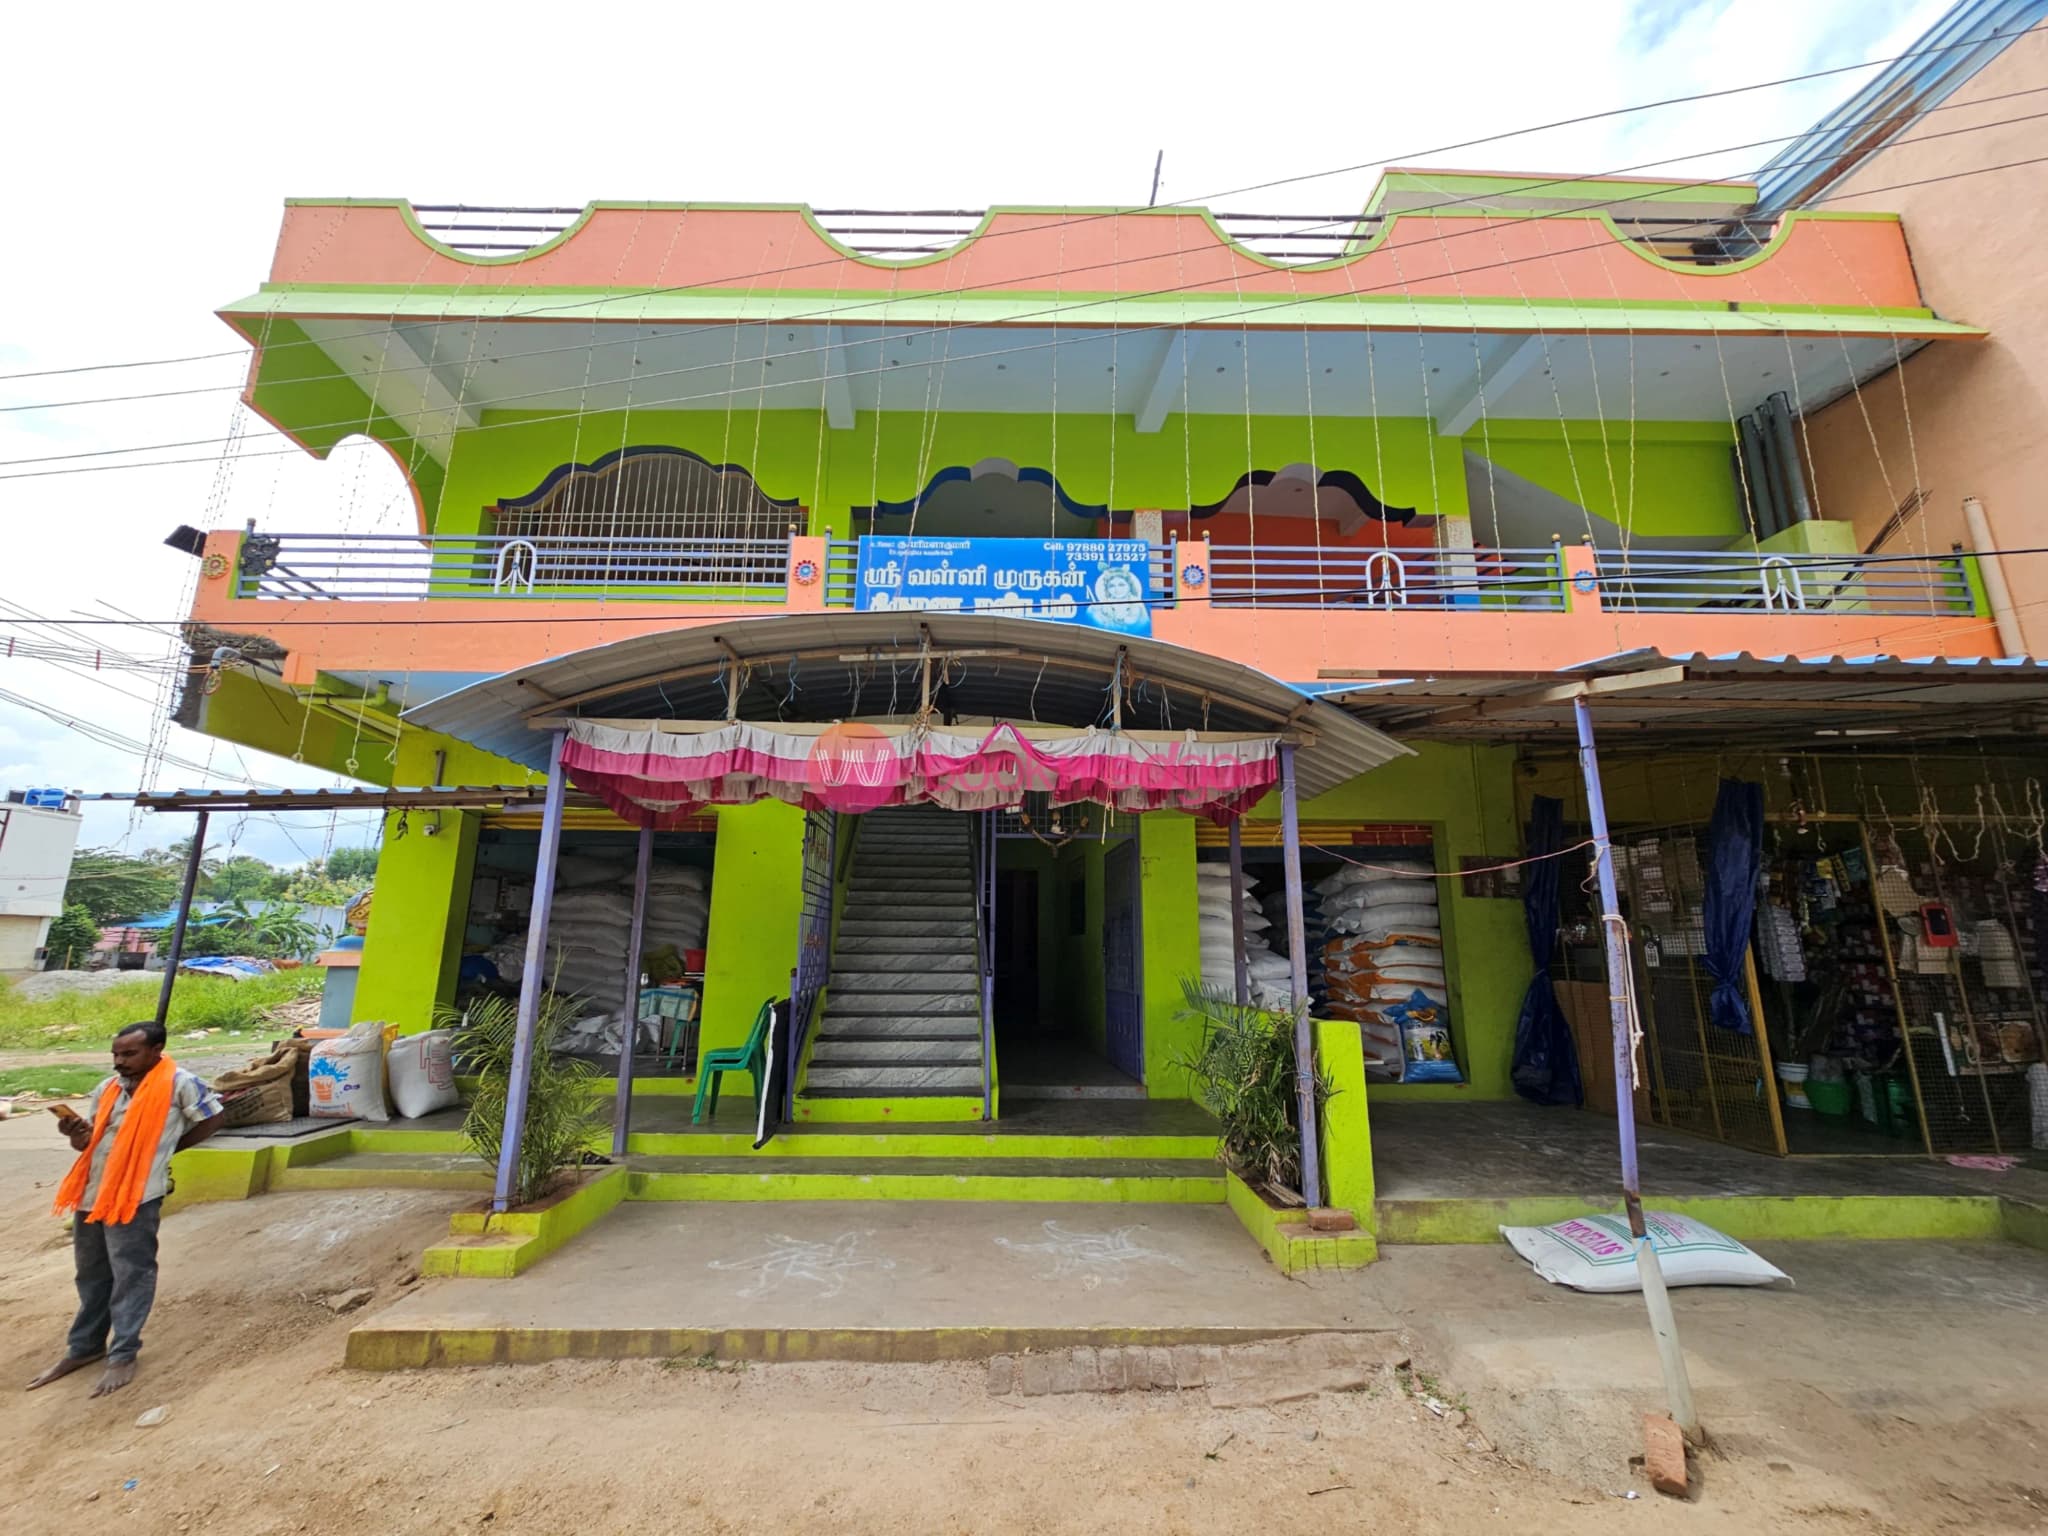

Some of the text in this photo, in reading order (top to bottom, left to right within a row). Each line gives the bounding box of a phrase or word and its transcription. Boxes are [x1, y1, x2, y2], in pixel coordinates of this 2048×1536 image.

[1066, 543, 1105, 552] 97880
[1065, 552, 1147, 561] 73391 12527
[864, 559, 1087, 591] ஸ்ரீ வள்ளி முருகன்
